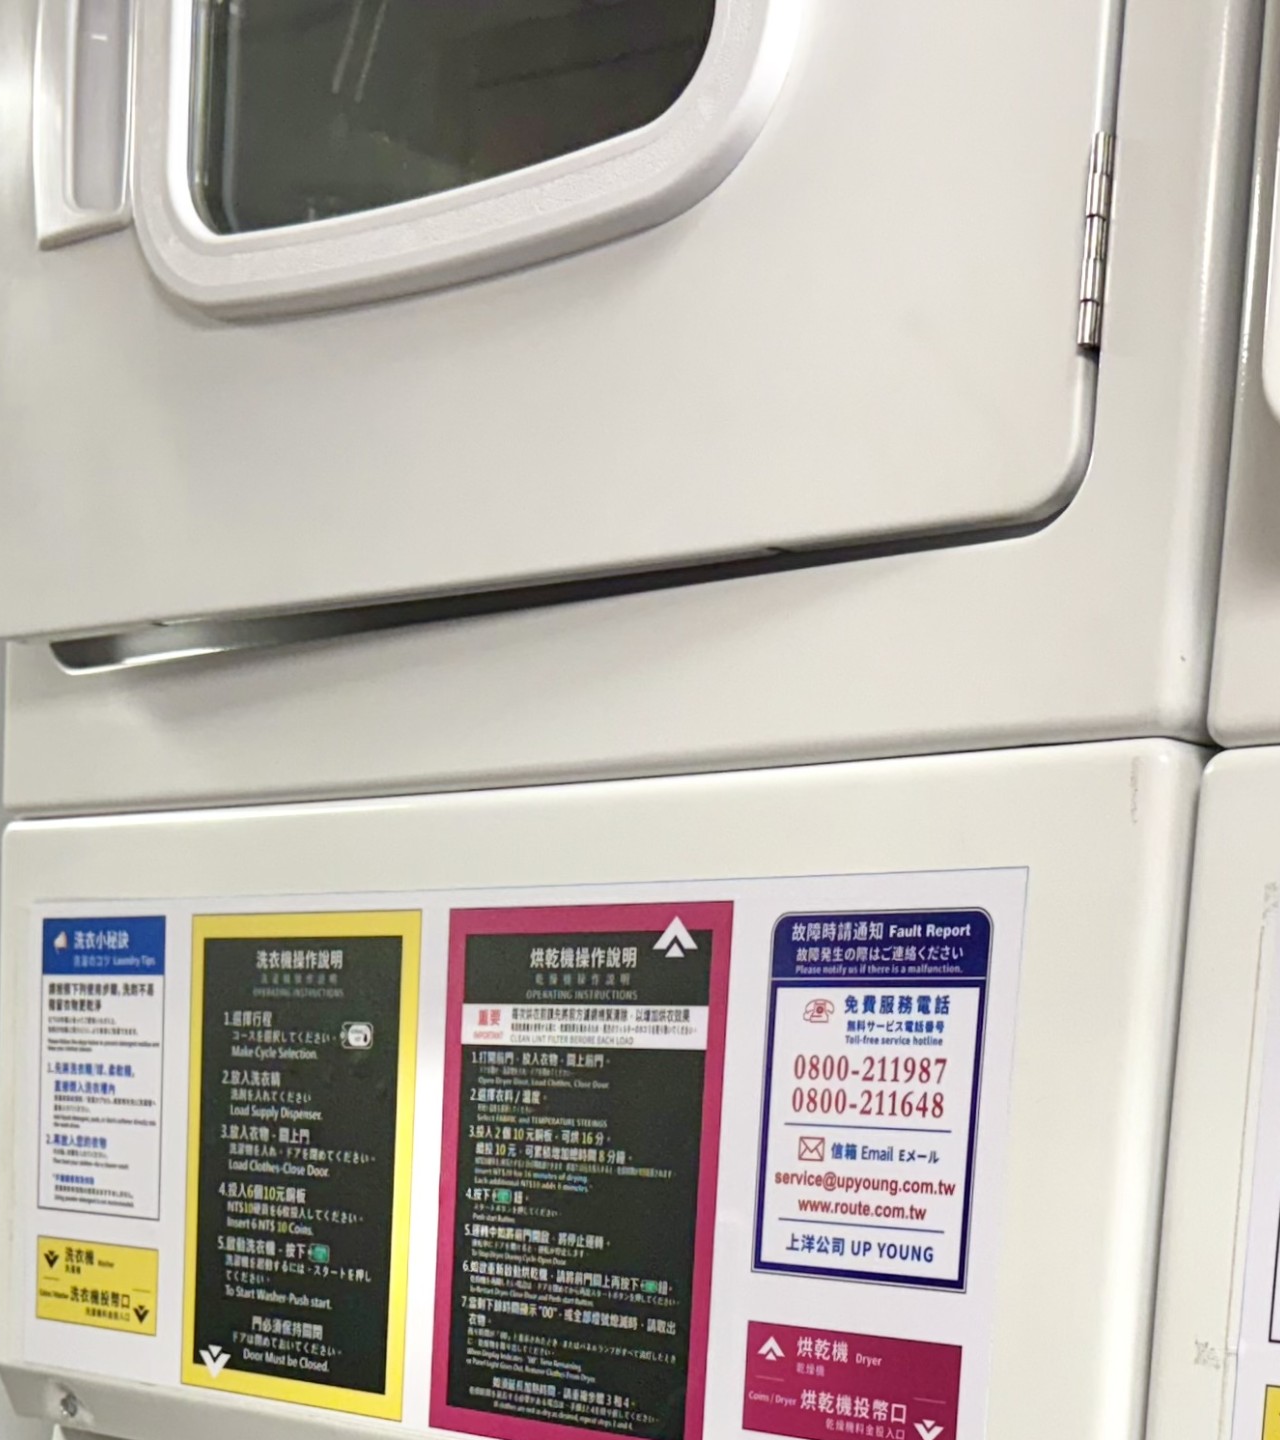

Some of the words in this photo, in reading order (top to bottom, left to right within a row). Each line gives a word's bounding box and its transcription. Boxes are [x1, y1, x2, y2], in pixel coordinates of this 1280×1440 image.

[792, 922, 883, 941] 故障時請通知
[889, 925, 922, 938] Fault
[926, 924, 971, 937] Report
[844, 995, 950, 1015] 免費服務電話
[794, 1054, 947, 1084] 0800-211987
[791, 1088, 945, 1119] 0800-211648
[831, 1142, 857, 1161] 信箱
[861, 1145, 893, 1162] Email
[775, 1170, 956, 1197] service@upyoung.com.tw
[798, 1198, 927, 1221] www.route.com.tw
[786, 1233, 846, 1257] 上洋公司
[851, 1240, 872, 1257] UP
[877, 1243, 934, 1263] YOUNG
[796, 1336, 849, 1364] 烘乾機
[856, 1353, 883, 1368] Dryer
[800, 1389, 908, 1425] 烘乾機投幣口
